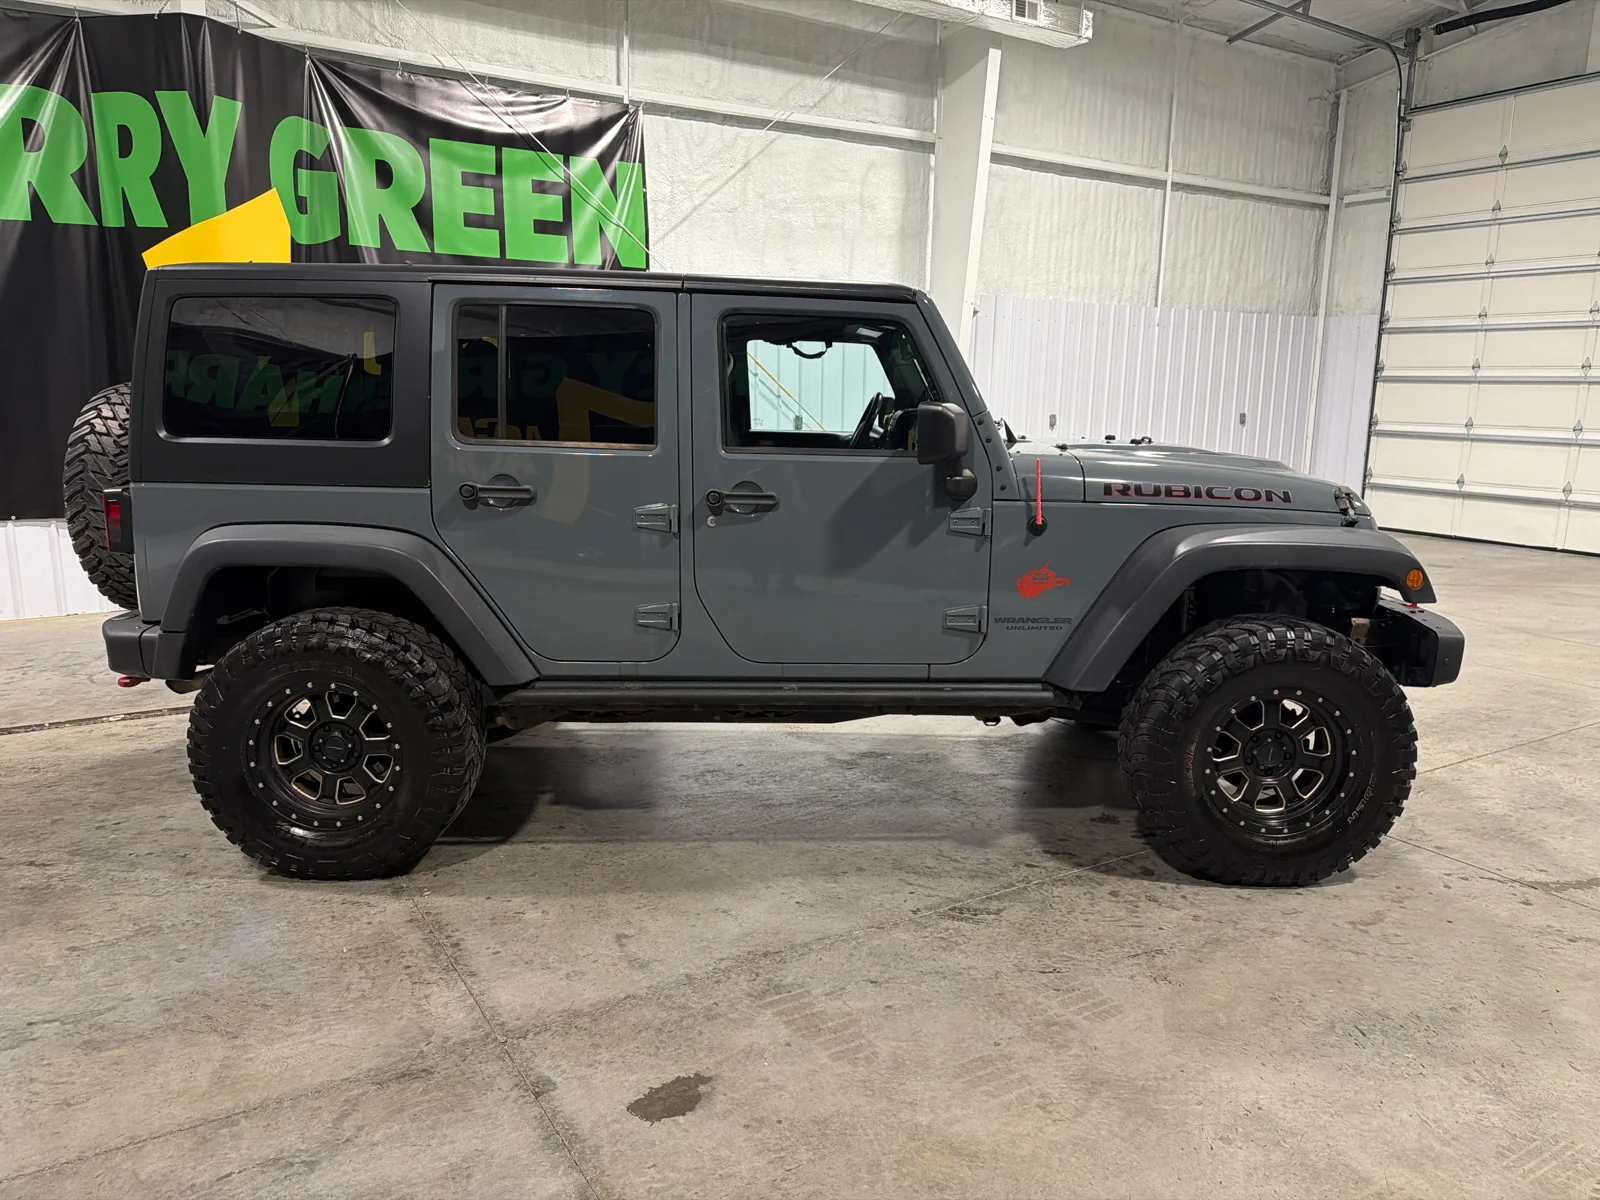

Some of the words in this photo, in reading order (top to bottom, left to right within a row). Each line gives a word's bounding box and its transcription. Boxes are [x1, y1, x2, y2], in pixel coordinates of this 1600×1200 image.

[269, 115, 647, 268] GREEN
[1103, 482, 1293, 503] RUBICON
[994, 617, 1073, 625] WRANGLER
